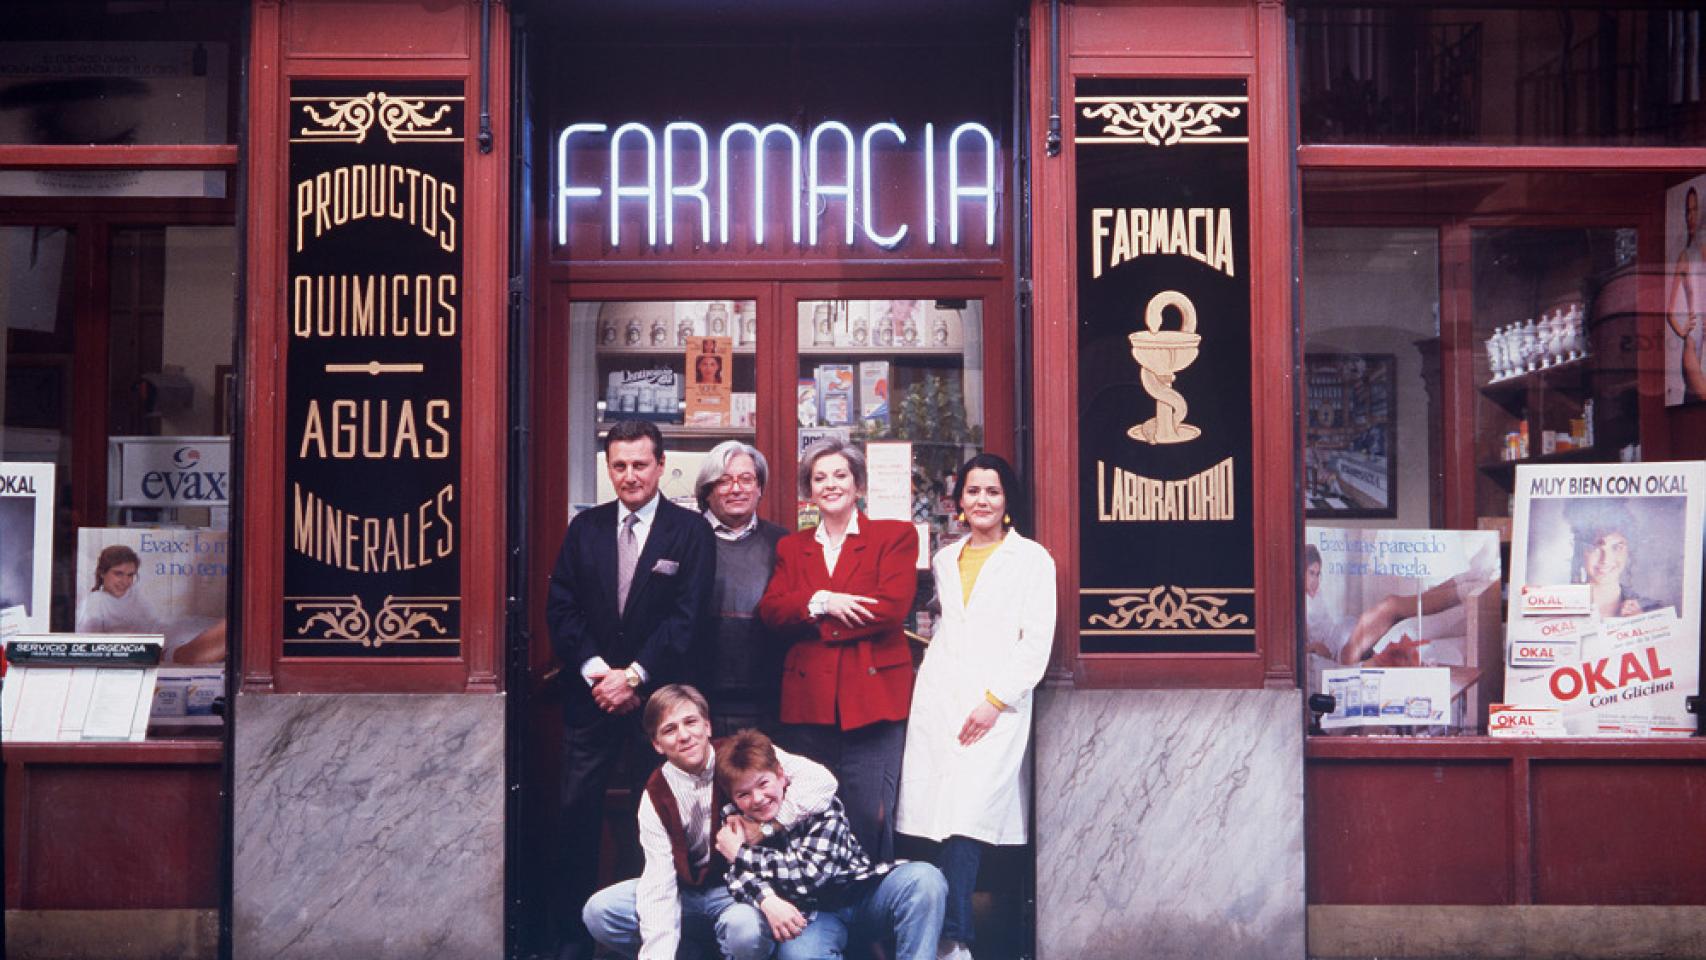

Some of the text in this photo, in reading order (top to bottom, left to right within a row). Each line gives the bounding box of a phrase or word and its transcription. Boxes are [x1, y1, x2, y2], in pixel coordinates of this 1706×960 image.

[558, 121, 996, 246] FARMACIA
[297, 164, 455, 252] PRODUCTOS
[1092, 207, 1235, 279] FARMACIA
[295, 275, 455, 338] QUIMICOS
[300, 400, 451, 458] AGUAS
[142, 471, 227, 500] evax
[1097, 456, 1234, 520] LABORATORIO
[1530, 474, 1687, 495] MUY BIEN CON OKAL
[294, 482, 453, 573] MINERALES
[1378, 536, 1446, 558] parecido
[1528, 596, 1563, 606] OKAL
[1541, 620, 1577, 636] OKAL
[16, 643, 146, 652] SERVICIO DE URGENCIA
[1520, 647, 1555, 657] OKAL
[1548, 647, 1672, 702] OKAL
[1589, 681, 1675, 708] Con Glicina
[1497, 715, 1535, 725] OKAL
